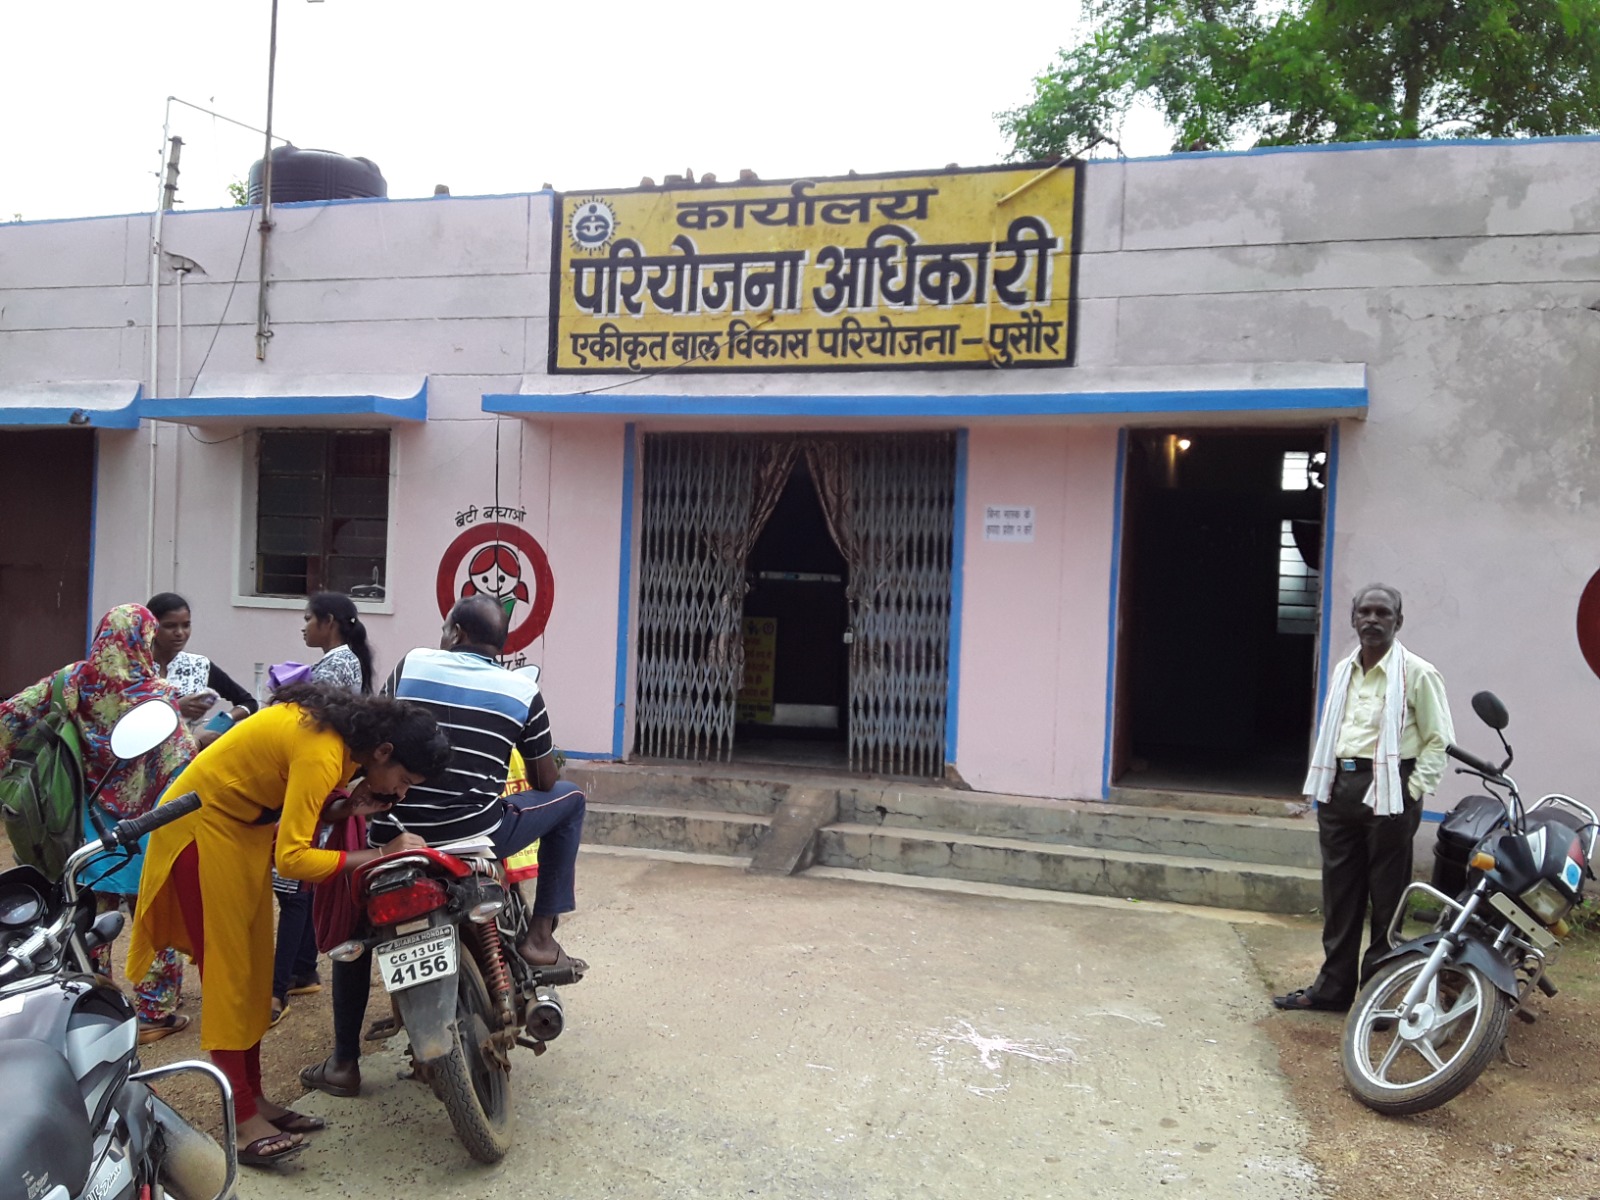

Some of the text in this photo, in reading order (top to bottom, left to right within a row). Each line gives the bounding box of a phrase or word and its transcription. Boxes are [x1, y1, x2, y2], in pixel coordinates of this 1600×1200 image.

[676, 180, 939, 229] कार्यालय
[570, 215, 1062, 317] परियोजना अधिकारी
[570, 322, 669, 370] एकीकृत
[672, 330, 723, 361] बाल
[728, 319, 813, 360] विकास
[817, 315, 961, 358] परियोजना
[989, 309, 1064, 365] पुसौर
[454, 504, 527, 527] बेटी बचाओ
[421, 928, 444, 941] HONDA
[390, 940, 444, 965] CG 13 UE
[390, 955, 449, 985] 4156
